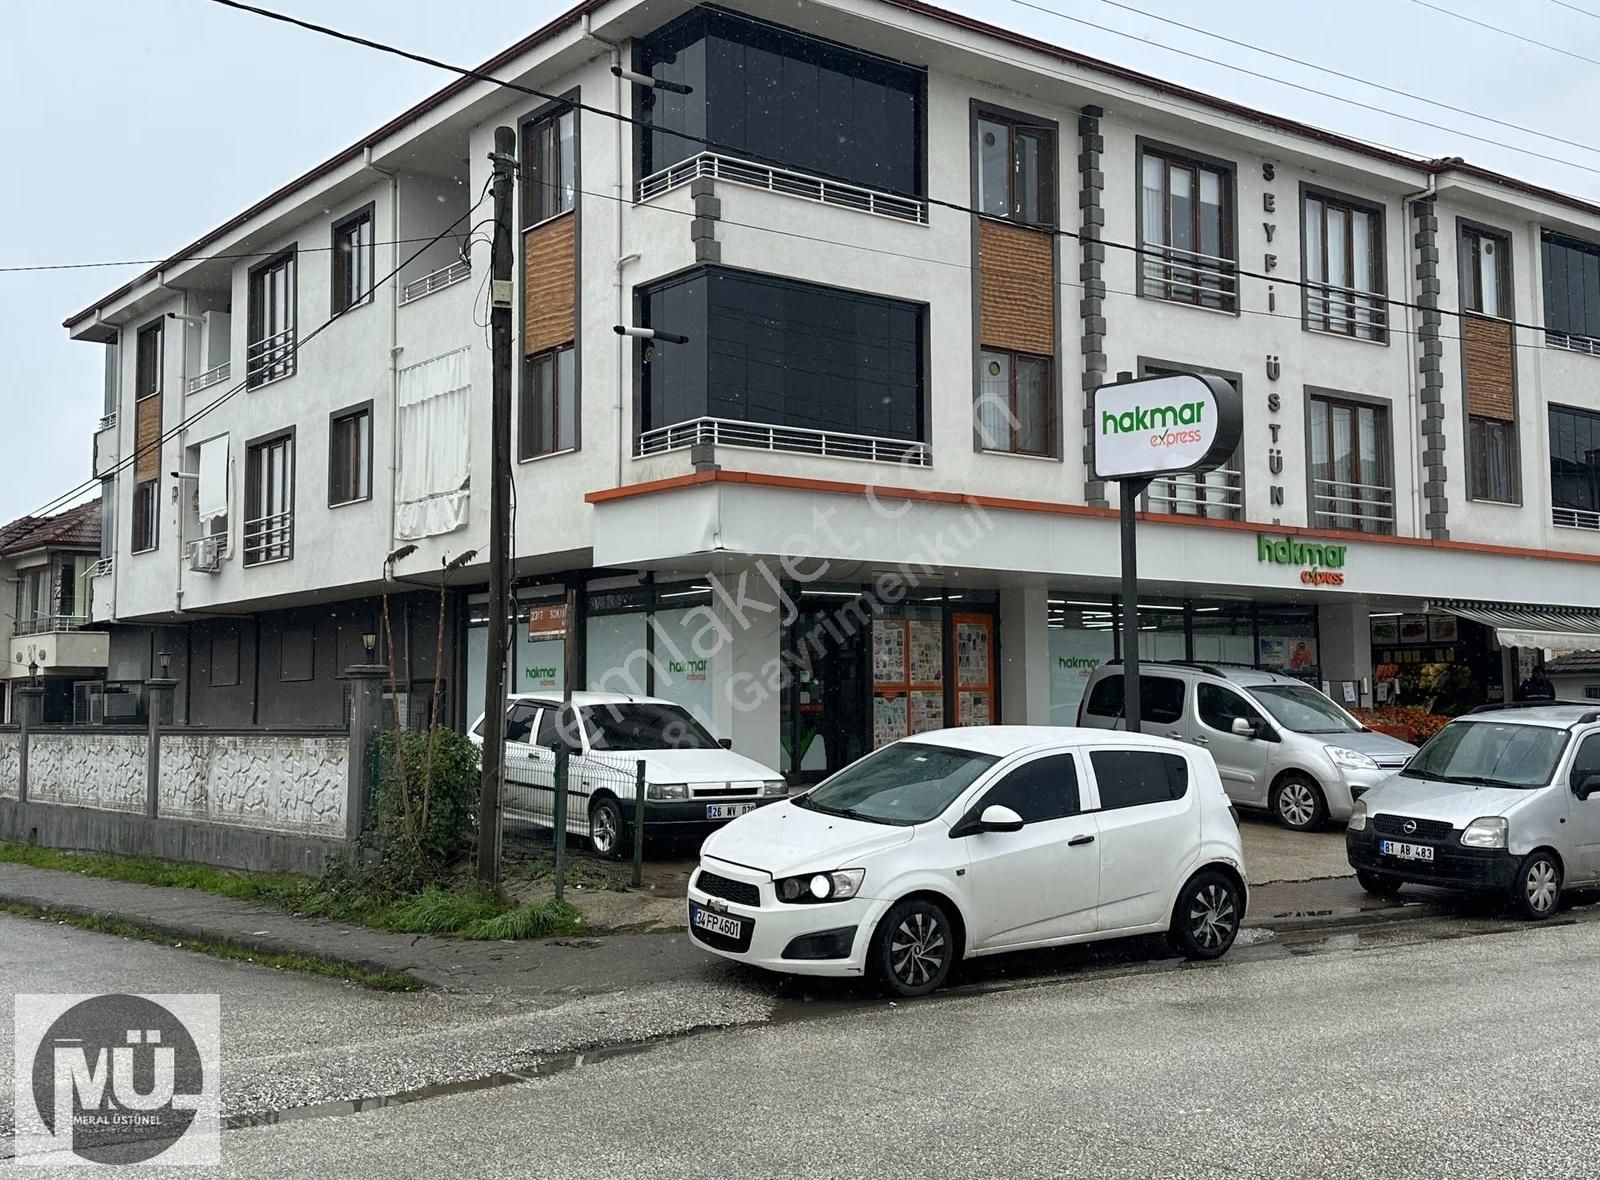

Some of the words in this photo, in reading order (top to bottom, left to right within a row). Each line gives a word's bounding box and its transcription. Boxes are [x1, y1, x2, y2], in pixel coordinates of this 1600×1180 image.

[1102, 401, 1204, 435] hakmar
[1150, 429, 1202, 447] express
[1266, 355, 1284, 524] ÜSTÜN
[1257, 534, 1347, 567] hakmar
[525, 667, 556, 679] hakmar
[669, 660, 707, 673] hakmar
[712, 807, 722, 817] 26
[1385, 842, 1394, 853] 81
[1401, 844, 1411, 855] AB
[1416, 847, 1432, 859] 483
[719, 918, 739, 938] 4601
